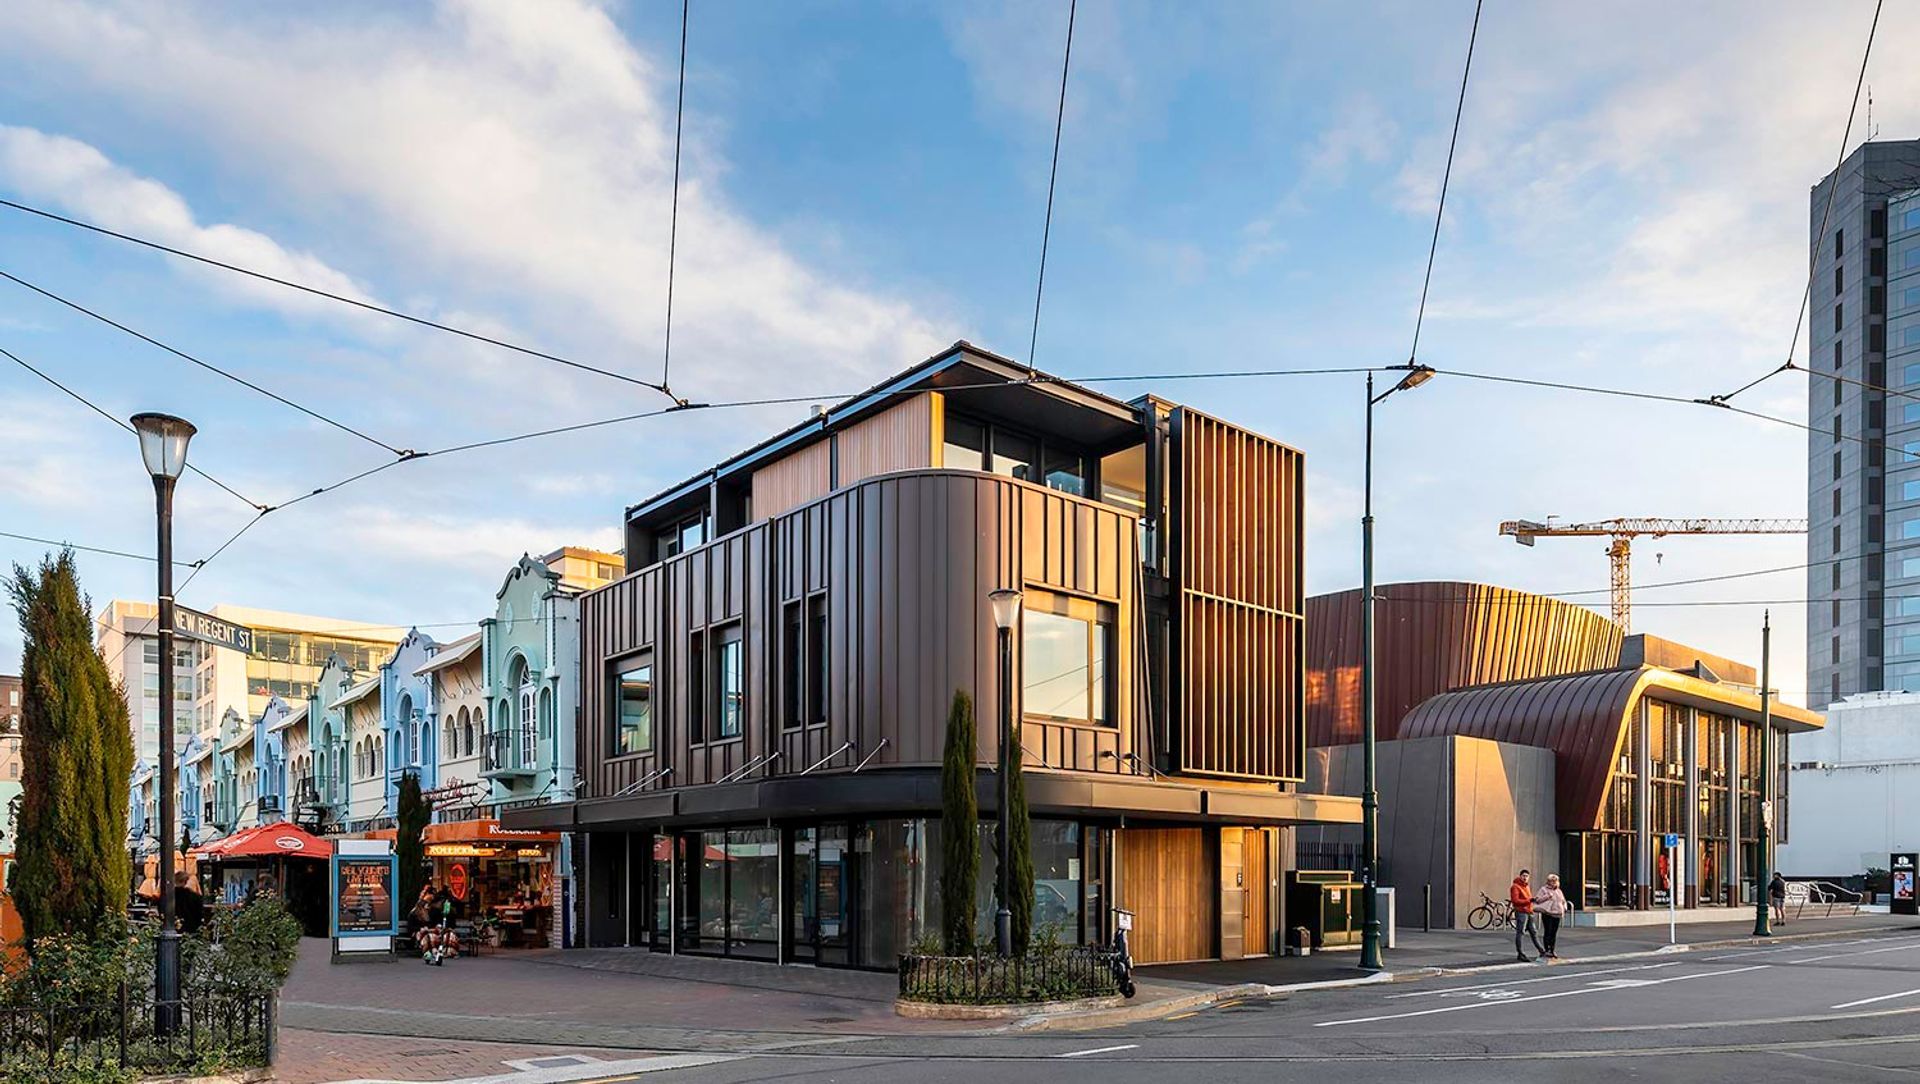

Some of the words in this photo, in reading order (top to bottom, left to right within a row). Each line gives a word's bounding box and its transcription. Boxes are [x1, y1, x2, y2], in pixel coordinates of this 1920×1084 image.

[174, 609, 196, 633] NEW
[198, 617, 236, 645] REGENT
[238, 630, 250, 649] ST
